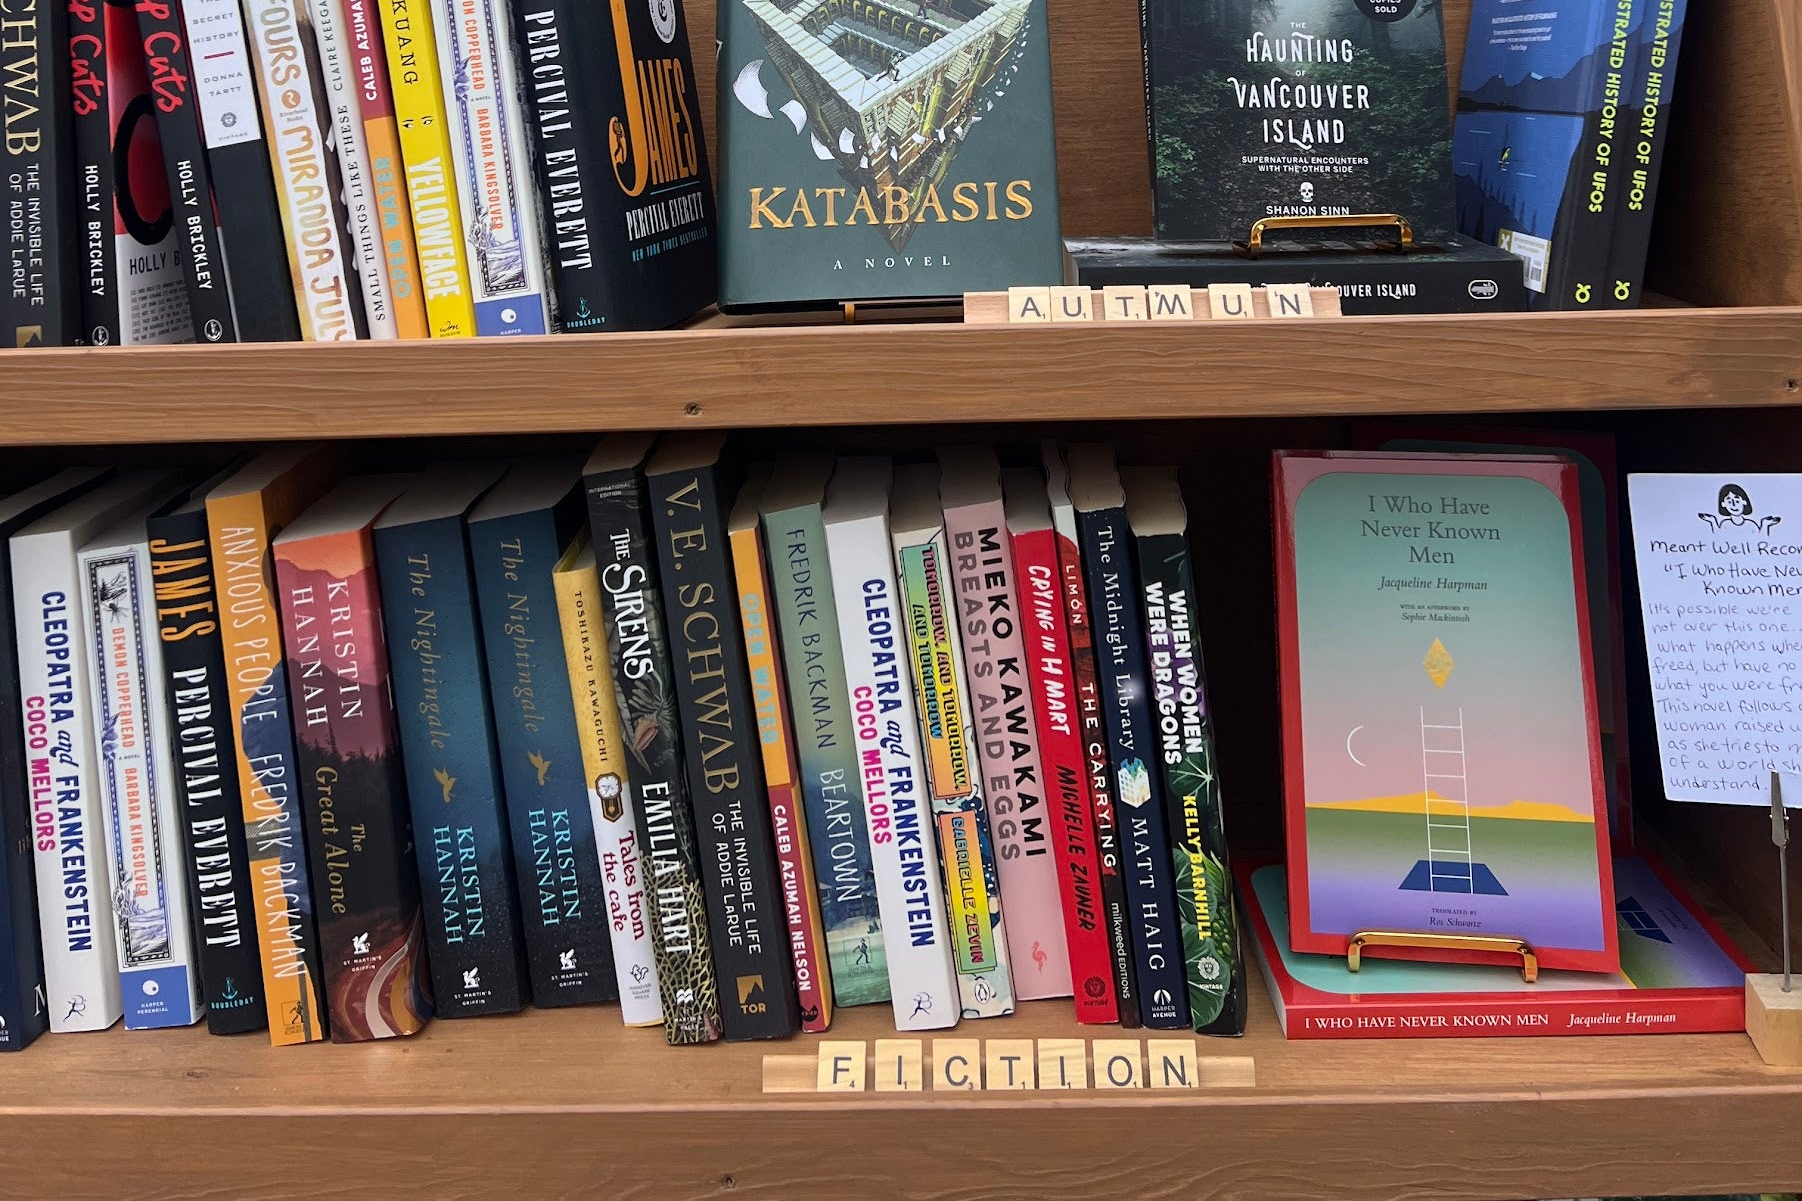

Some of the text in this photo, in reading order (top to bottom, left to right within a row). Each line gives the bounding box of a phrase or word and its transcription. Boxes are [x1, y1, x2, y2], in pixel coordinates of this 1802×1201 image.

[192, 13, 234, 25] SECRET
[193, 31, 240, 44] HISTORY
[1374, 5, 1398, 13] SOLD
[70, 34, 105, 116] Cuts
[203, 71, 243, 84] DONNA
[464, 19, 485, 90] COPPERHEAD
[524, 9, 572, 139] PERCIVAL
[1246, 31, 1354, 63] HAUNTING
[209, 86, 242, 97] TARTT
[360, 56, 378, 101] CALEB
[1227, 77, 1370, 110] VANCOUVER
[1599, 72, 1622, 139] HISTORY
[477, 108, 494, 159] BARBARA
[1241, 155, 1369, 165] SUPERNATURAL ENCOUNTERS
[1263, 118, 1345, 150] ISLAND
[1595, 142, 1611, 166] OF
[374, 157, 398, 229] WATER
[484, 162, 504, 230] KINGSOLVER
[545, 148, 592, 270] EVERETT
[748, 179, 1034, 229] KATABASIS
[1265, 205, 1350, 216] SHANON SINN
[1588, 171, 1607, 213] UFOS
[27, 163, 44, 306] THE INVISIBLE LIFE
[85, 165, 104, 296] HOLLY BRICKLEY
[177, 160, 213, 290] HOLLY BRICKLEY
[384, 240, 412, 298] OPEN
[588, 482, 631, 494] INTERNATIONAL
[599, 490, 622, 499] EDITION
[1368, 495, 1490, 515] I Who Have
[1360, 519, 1501, 540] Never Known
[1408, 546, 1455, 564] Men
[220, 527, 267, 629] ANXIOUS
[1378, 576, 1488, 592] Jacqueline Harpman
[1401, 612, 1470, 623] Sophie Mackintosh
[1676, 604, 1739, 619] possible
[292, 585, 329, 727] HANNAH
[327, 579, 364, 719] KRISTIN
[408, 553, 452, 749] The Nightingale
[574, 590, 608, 762] TOSHIKAZU KAWAGUCHI
[1145, 581, 1182, 765] WERE DRAGONS
[1169, 590, 1203, 754] WHEN WOMEN
[1702, 656, 1729, 673] but
[1733, 656, 1771, 673] have
[1778, 662, 1796, 672] no
[234, 637, 278, 725] PEOPLE
[954, 531, 1021, 861] BREASTS AND EGGS
[978, 527, 1047, 857] MIEKO KAWAKAMI
[1656, 698, 1793, 715] This novel follows
[786, 528, 863, 903] FREDRIK BACKMAN BEARTOWN
[1663, 721, 1727, 732] woman
[1734, 718, 1784, 733] raised
[26, 696, 56, 852] COCO MELLORS
[853, 686, 893, 845] COCO MELLORS
[862, 578, 935, 948] CLEOPATRA and FRANKENSTEIN
[1098, 525, 1166, 971] The Midnight Library MATT HAIG
[248, 753, 293, 852] FREDRIK
[351, 823, 366, 852] The
[528, 808, 560, 927] HANNAH
[551, 808, 581, 920] KRISTIN
[602, 852, 616, 883] the
[1182, 795, 1213, 941] KELLY BARNHILL
[433, 824, 464, 944] HANNAH
[457, 825, 486, 938] KRISTIN
[618, 830, 646, 941] Tales from
[951, 816, 983, 965] GABRIELLE ZEVIN
[261, 861, 308, 979] BACKMAN
[136, 1006, 169, 1015] PERENNIAL
[141, 1001, 164, 1009] HARPER
[210, 996, 254, 1009] DOUBLEDAY
[740, 1002, 766, 1014] TOR
[1305, 1012, 1677, 1029] I WHO HAVE NEVER KNOWN MEN Jacqueline Harpman
